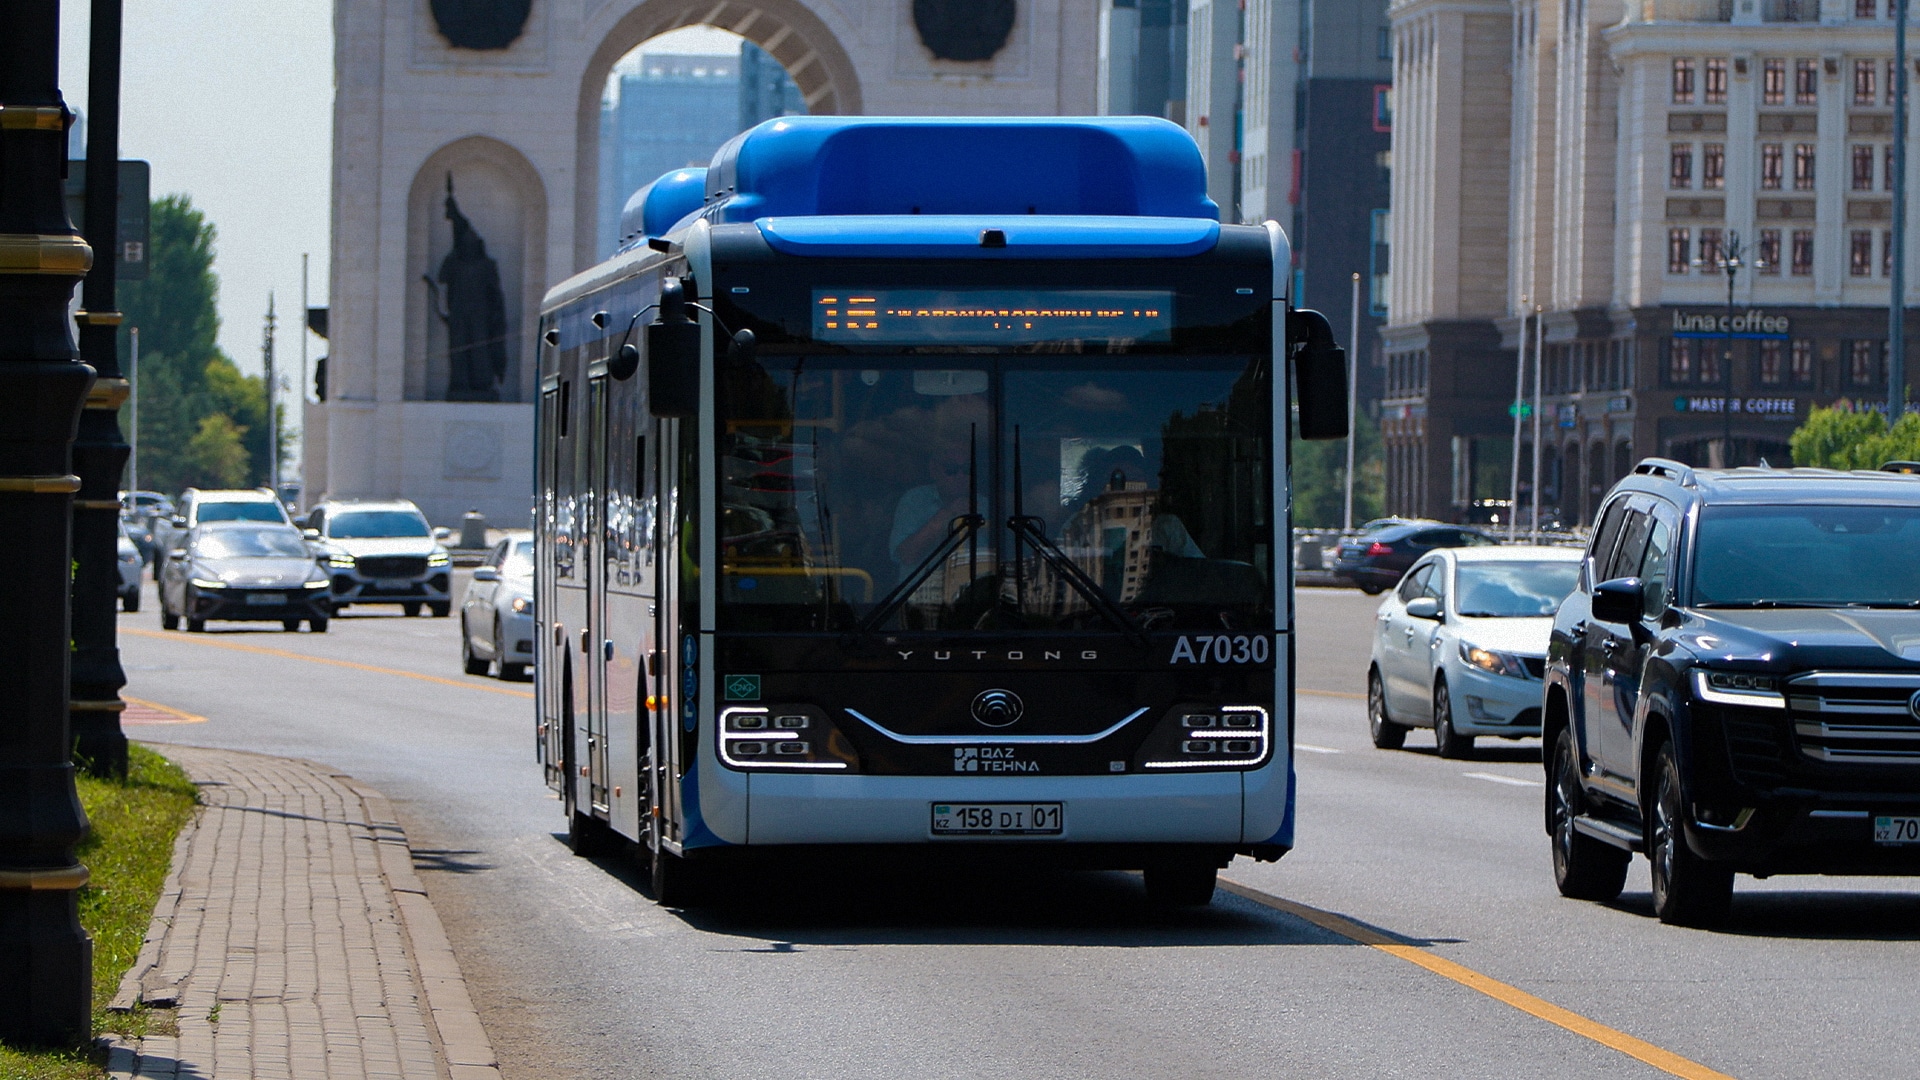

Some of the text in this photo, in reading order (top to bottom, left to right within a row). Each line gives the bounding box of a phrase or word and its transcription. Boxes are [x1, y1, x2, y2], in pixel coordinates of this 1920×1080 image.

[1719, 310, 1789, 333] coffee
[1745, 397, 1796, 414] COFFEE
[898, 651, 1097, 660] YUTONG
[1170, 635, 1269, 664] A7030
[981, 748, 1015, 759] QAZ
[981, 761, 1040, 772] TEHNA
[935, 807, 1058, 829] KZ 158 DI 01
[1876, 830, 1890, 840] KZ
